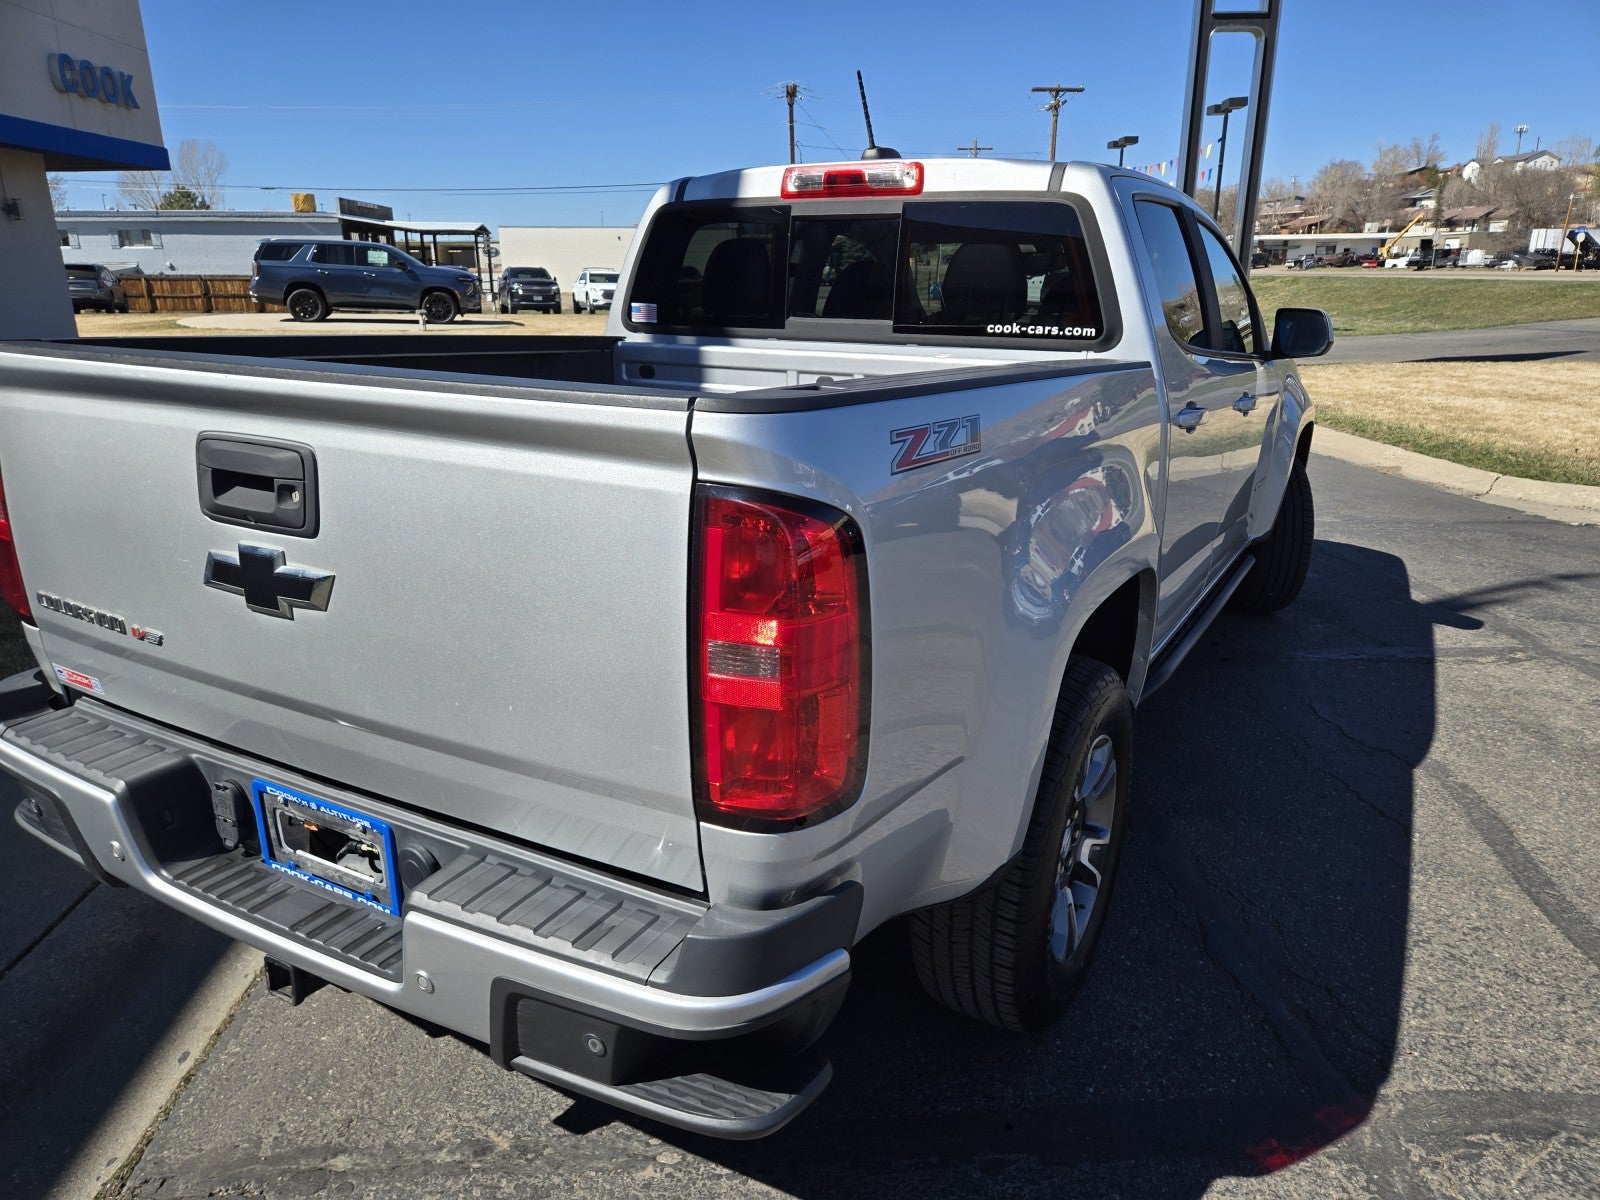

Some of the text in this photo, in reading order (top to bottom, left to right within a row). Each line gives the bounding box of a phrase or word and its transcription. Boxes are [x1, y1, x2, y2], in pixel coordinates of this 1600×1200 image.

[50, 53, 140, 109] COOK
[986, 323, 1096, 337] cook-cars.com
[890, 414, 981, 476] Z71
[319, 806, 372, 829] ALTITUDE
